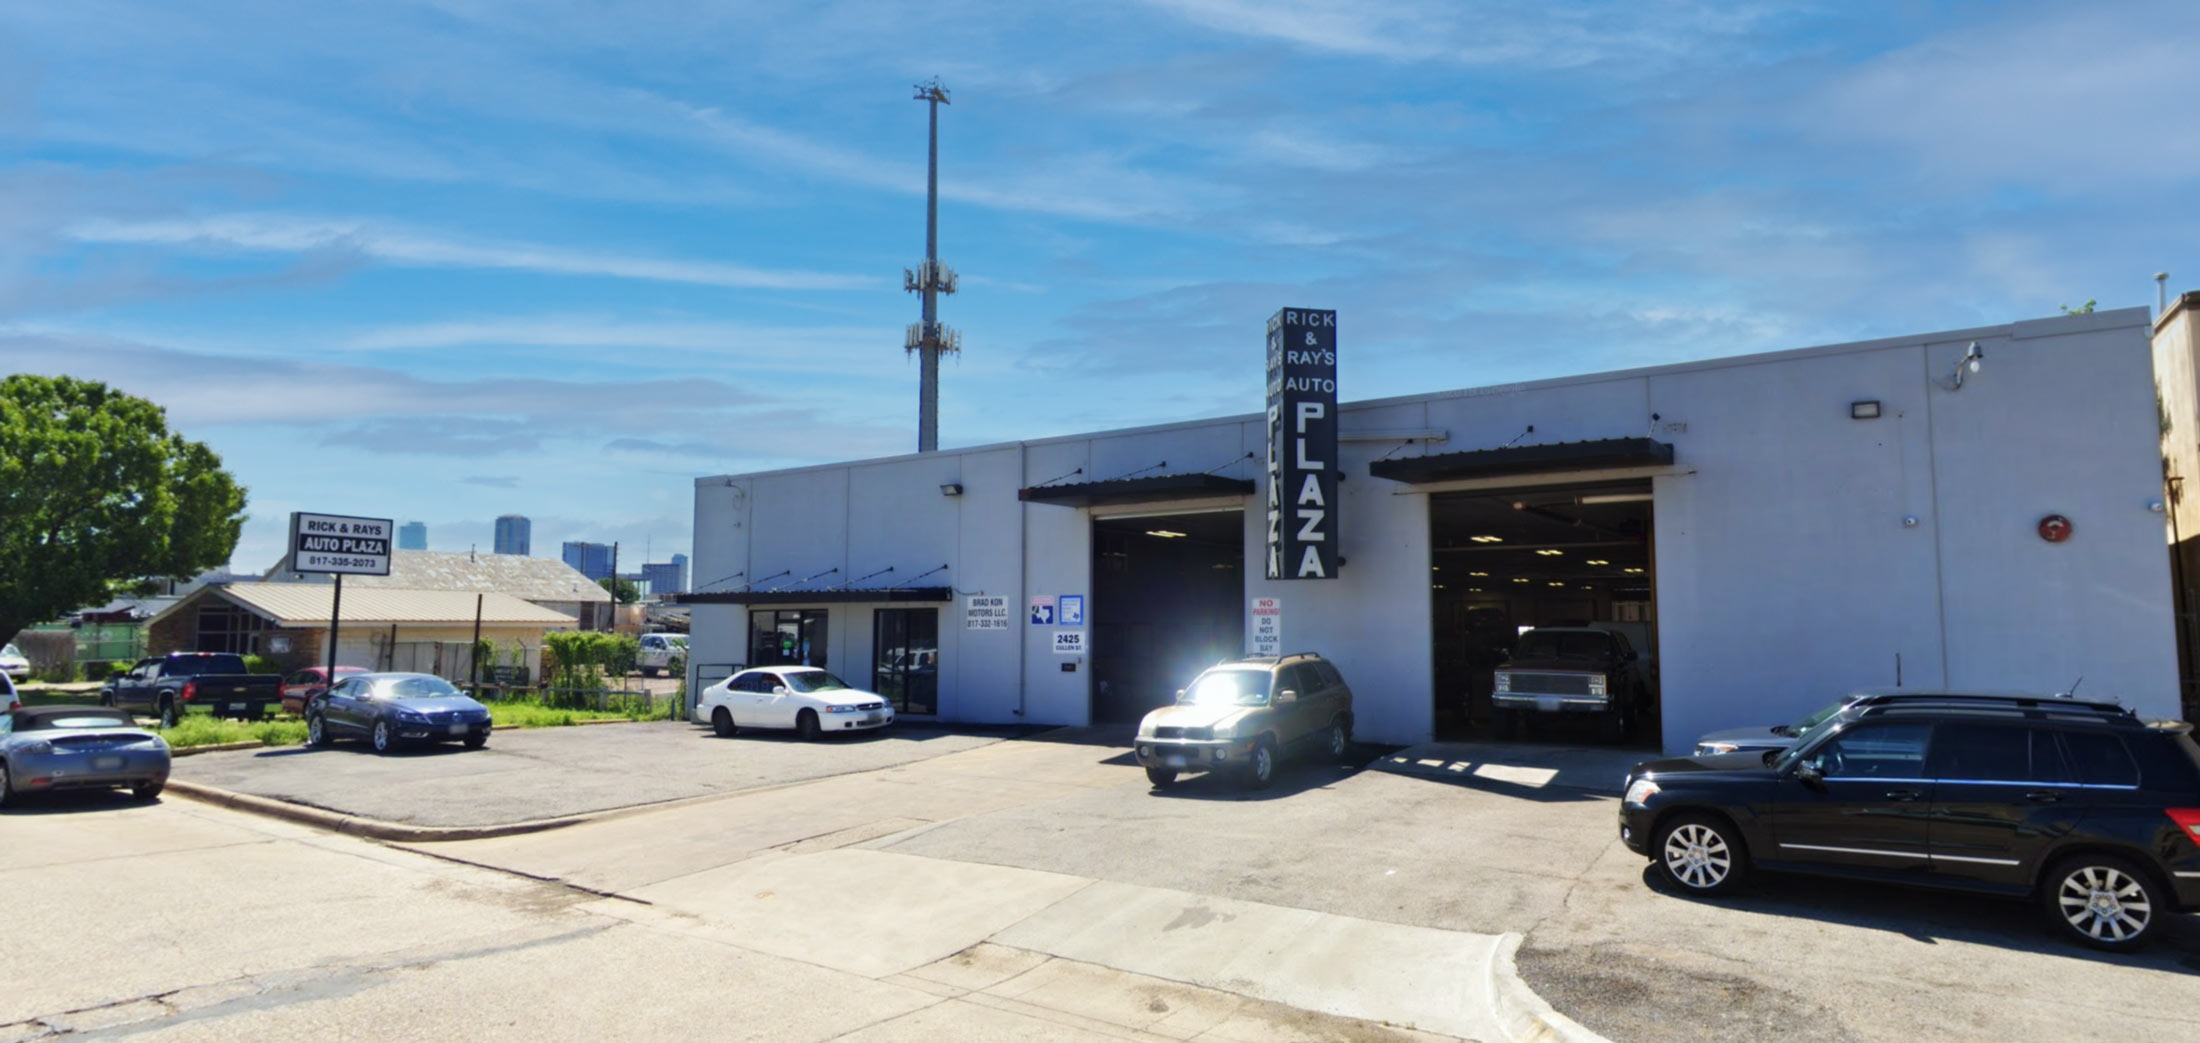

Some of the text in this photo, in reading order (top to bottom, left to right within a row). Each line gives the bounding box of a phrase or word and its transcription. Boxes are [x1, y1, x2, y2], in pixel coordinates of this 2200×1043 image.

[1286, 311, 1335, 327] RICK
[1305, 331, 1318, 345] &
[1287, 348, 1335, 366] RAY'S
[1285, 377, 1335, 393] AUTO
[1267, 404, 1279, 577] PLAZA
[1296, 402, 1326, 577] PLAZA
[307, 520, 382, 535] RICK & RAYS
[304, 537, 384, 554] AUTO PLAZA
[309, 556, 376, 568] 817-335-2073
[972, 598, 989, 606] BRAD
[968, 609, 993, 617] MOTORS
[1057, 634, 1080, 644] 2425
